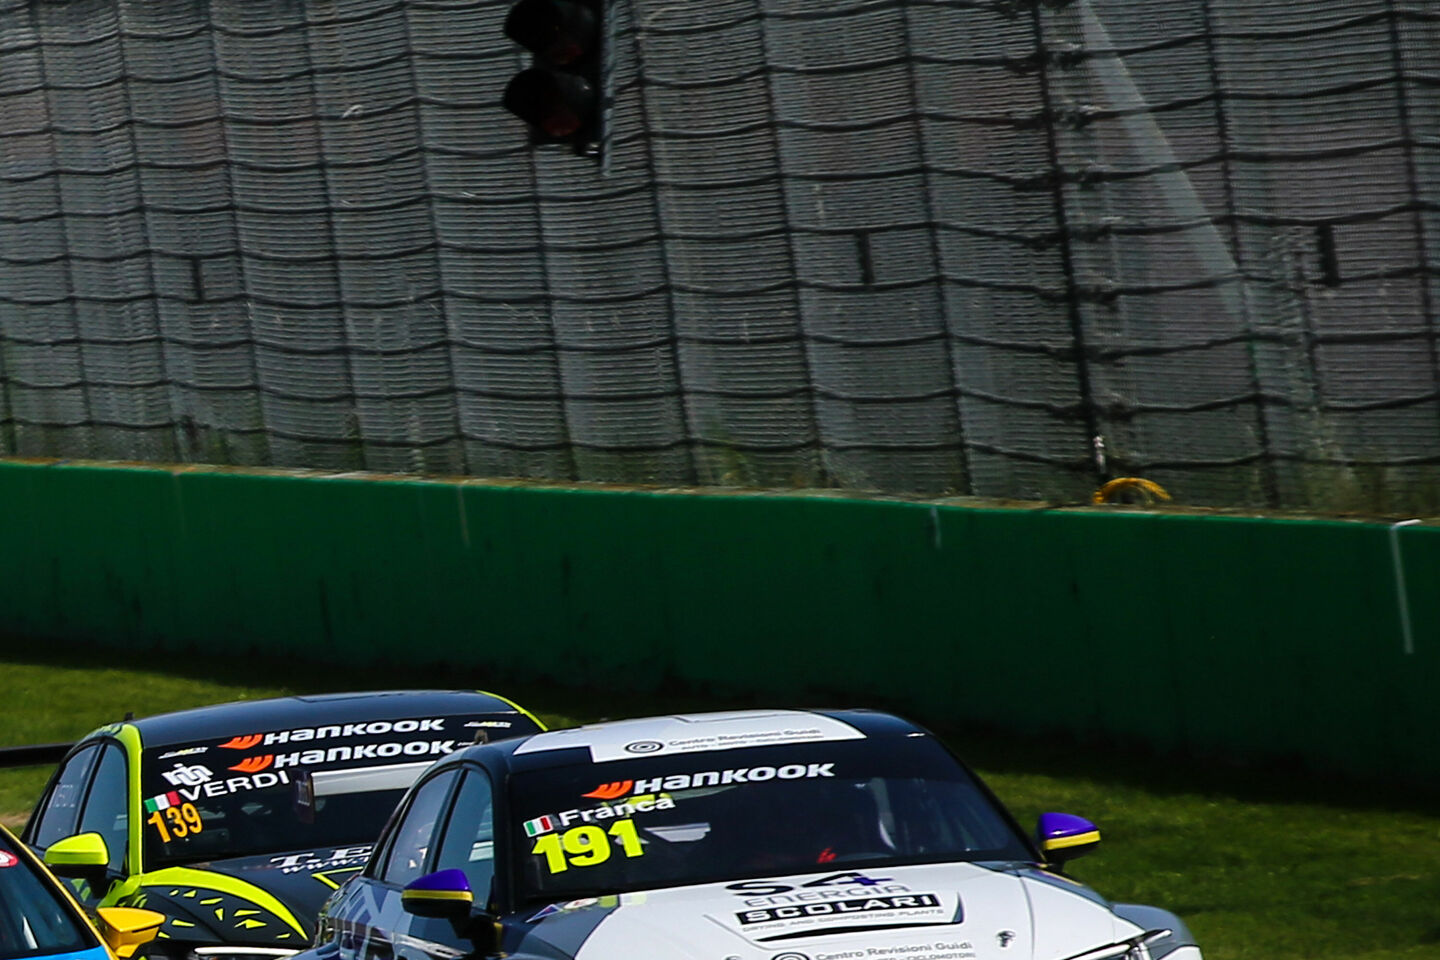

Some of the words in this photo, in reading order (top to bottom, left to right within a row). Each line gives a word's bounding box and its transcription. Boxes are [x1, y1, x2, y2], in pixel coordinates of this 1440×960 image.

[178, 770, 289, 802] VERDI
[147, 802, 203, 843] 139
[559, 797, 675, 828] Franca
[531, 818, 646, 875] 191
[745, 894, 933, 922] SCOLARI
[867, 943, 933, 956] Revisioni
[935, 941, 973, 951] Guidi
